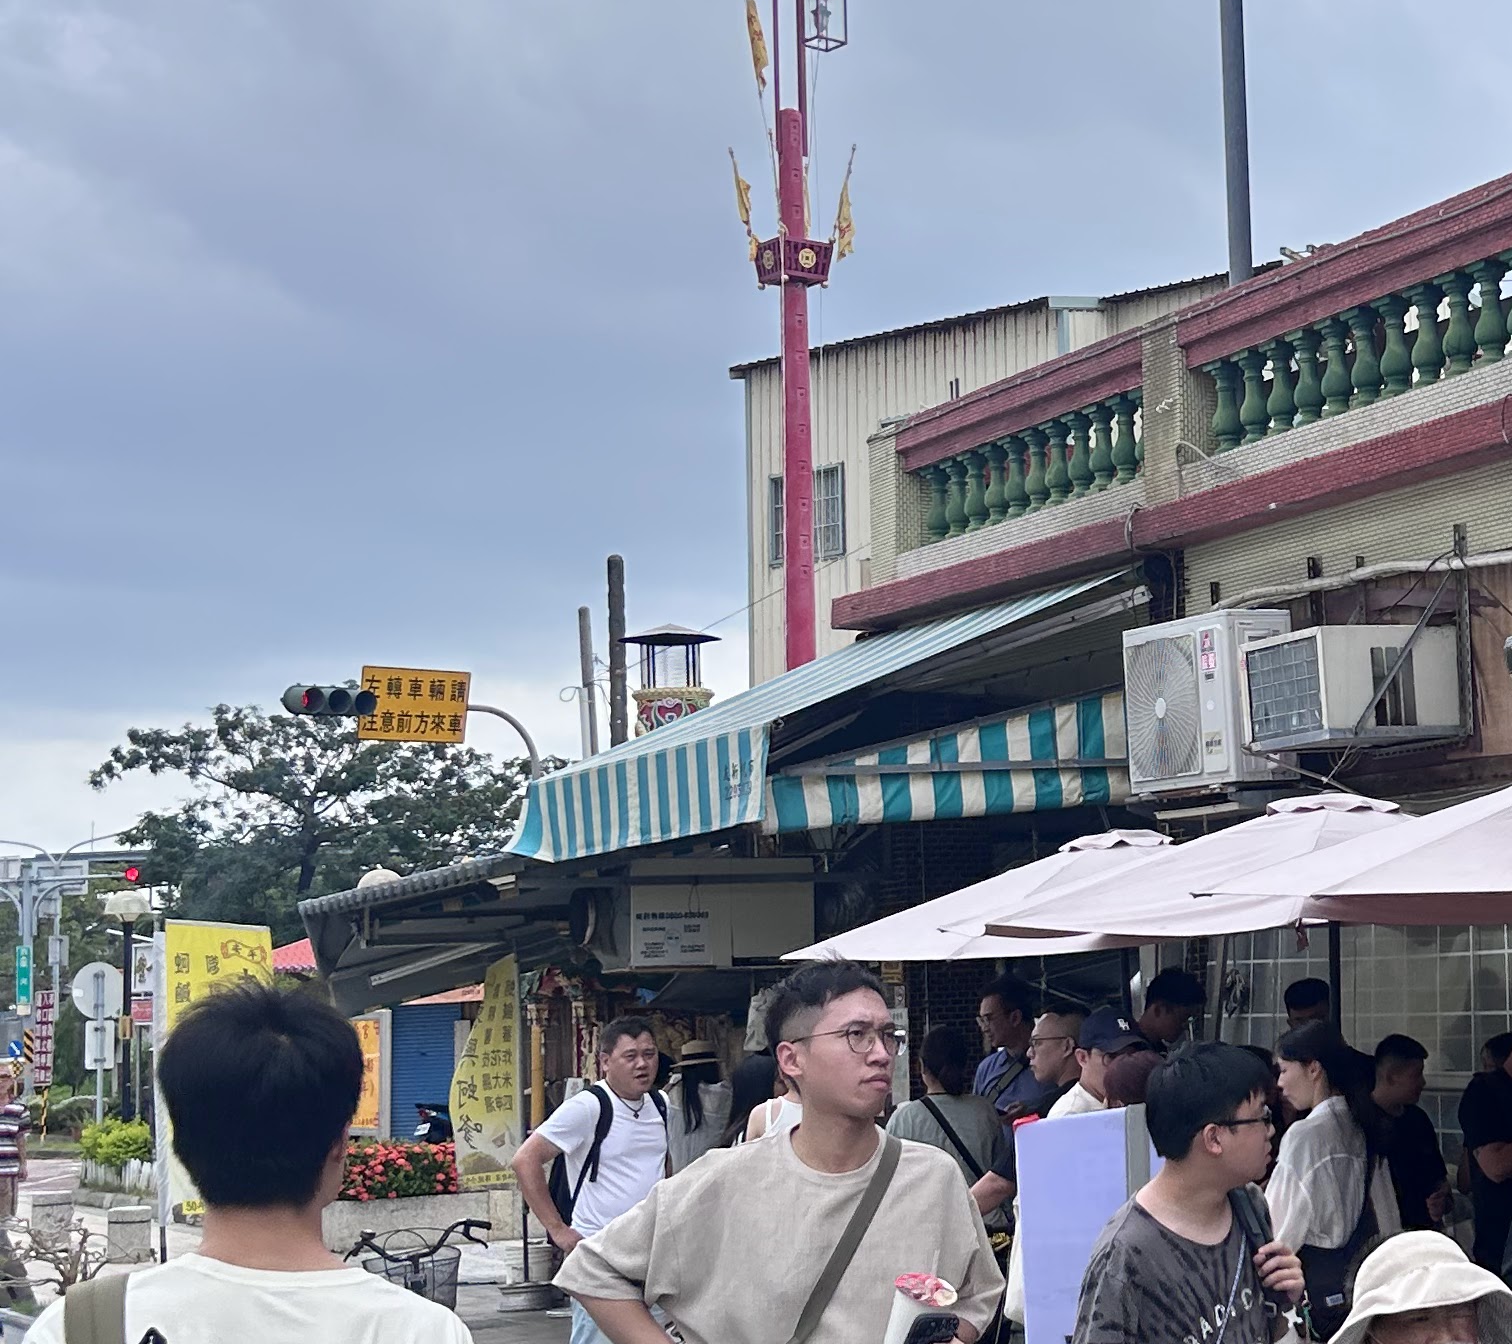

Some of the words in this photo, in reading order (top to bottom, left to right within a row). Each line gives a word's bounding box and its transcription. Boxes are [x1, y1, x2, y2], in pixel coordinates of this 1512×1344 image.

[362, 709, 463, 736] 注意前方來車
